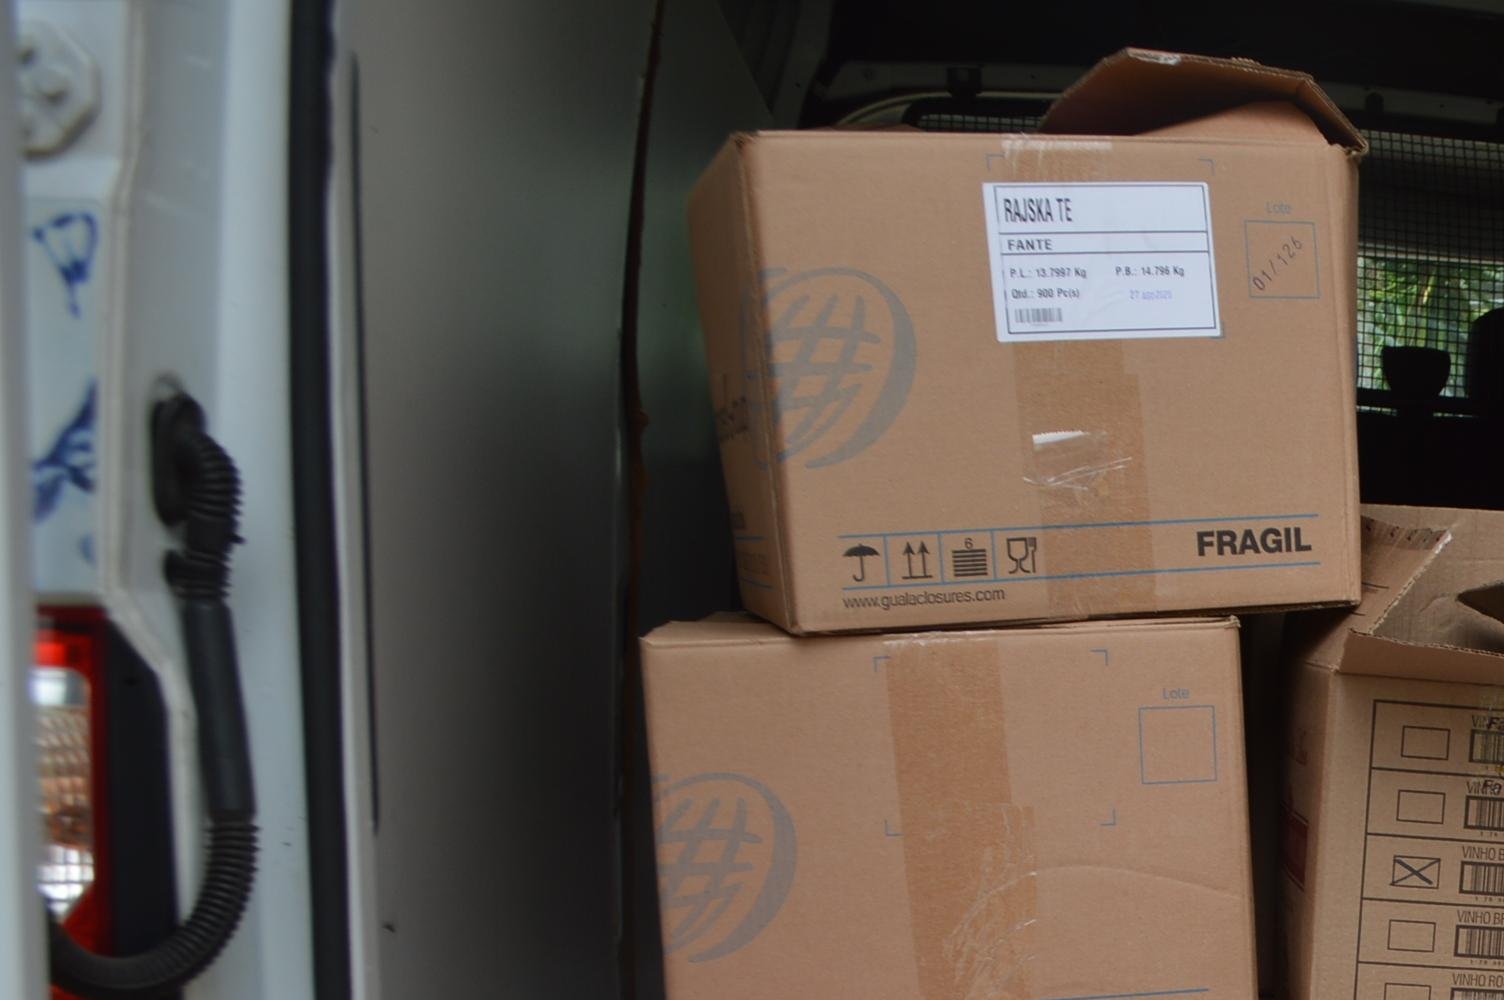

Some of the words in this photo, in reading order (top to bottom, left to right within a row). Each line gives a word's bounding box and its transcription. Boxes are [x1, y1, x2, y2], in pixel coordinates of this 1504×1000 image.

[1003, 197, 1053, 222] RAJSKA
[1056, 197, 1073, 222] TE
[1007, 239, 1053, 251] FANTE
[1074, 267, 1088, 279] Kg
[1173, 265, 1185, 277] Kg
[964, 538, 974, 549] 6
[1196, 527, 1313, 557] FRAGIL
[843, 587, 1006, 611] www.gualaclosures.com
[1163, 687, 1190, 700] Lote
[1461, 845, 1497, 861] VINHO
[1456, 910, 1491, 925] VINHO
[1451, 973, 1486, 988] VINHO
